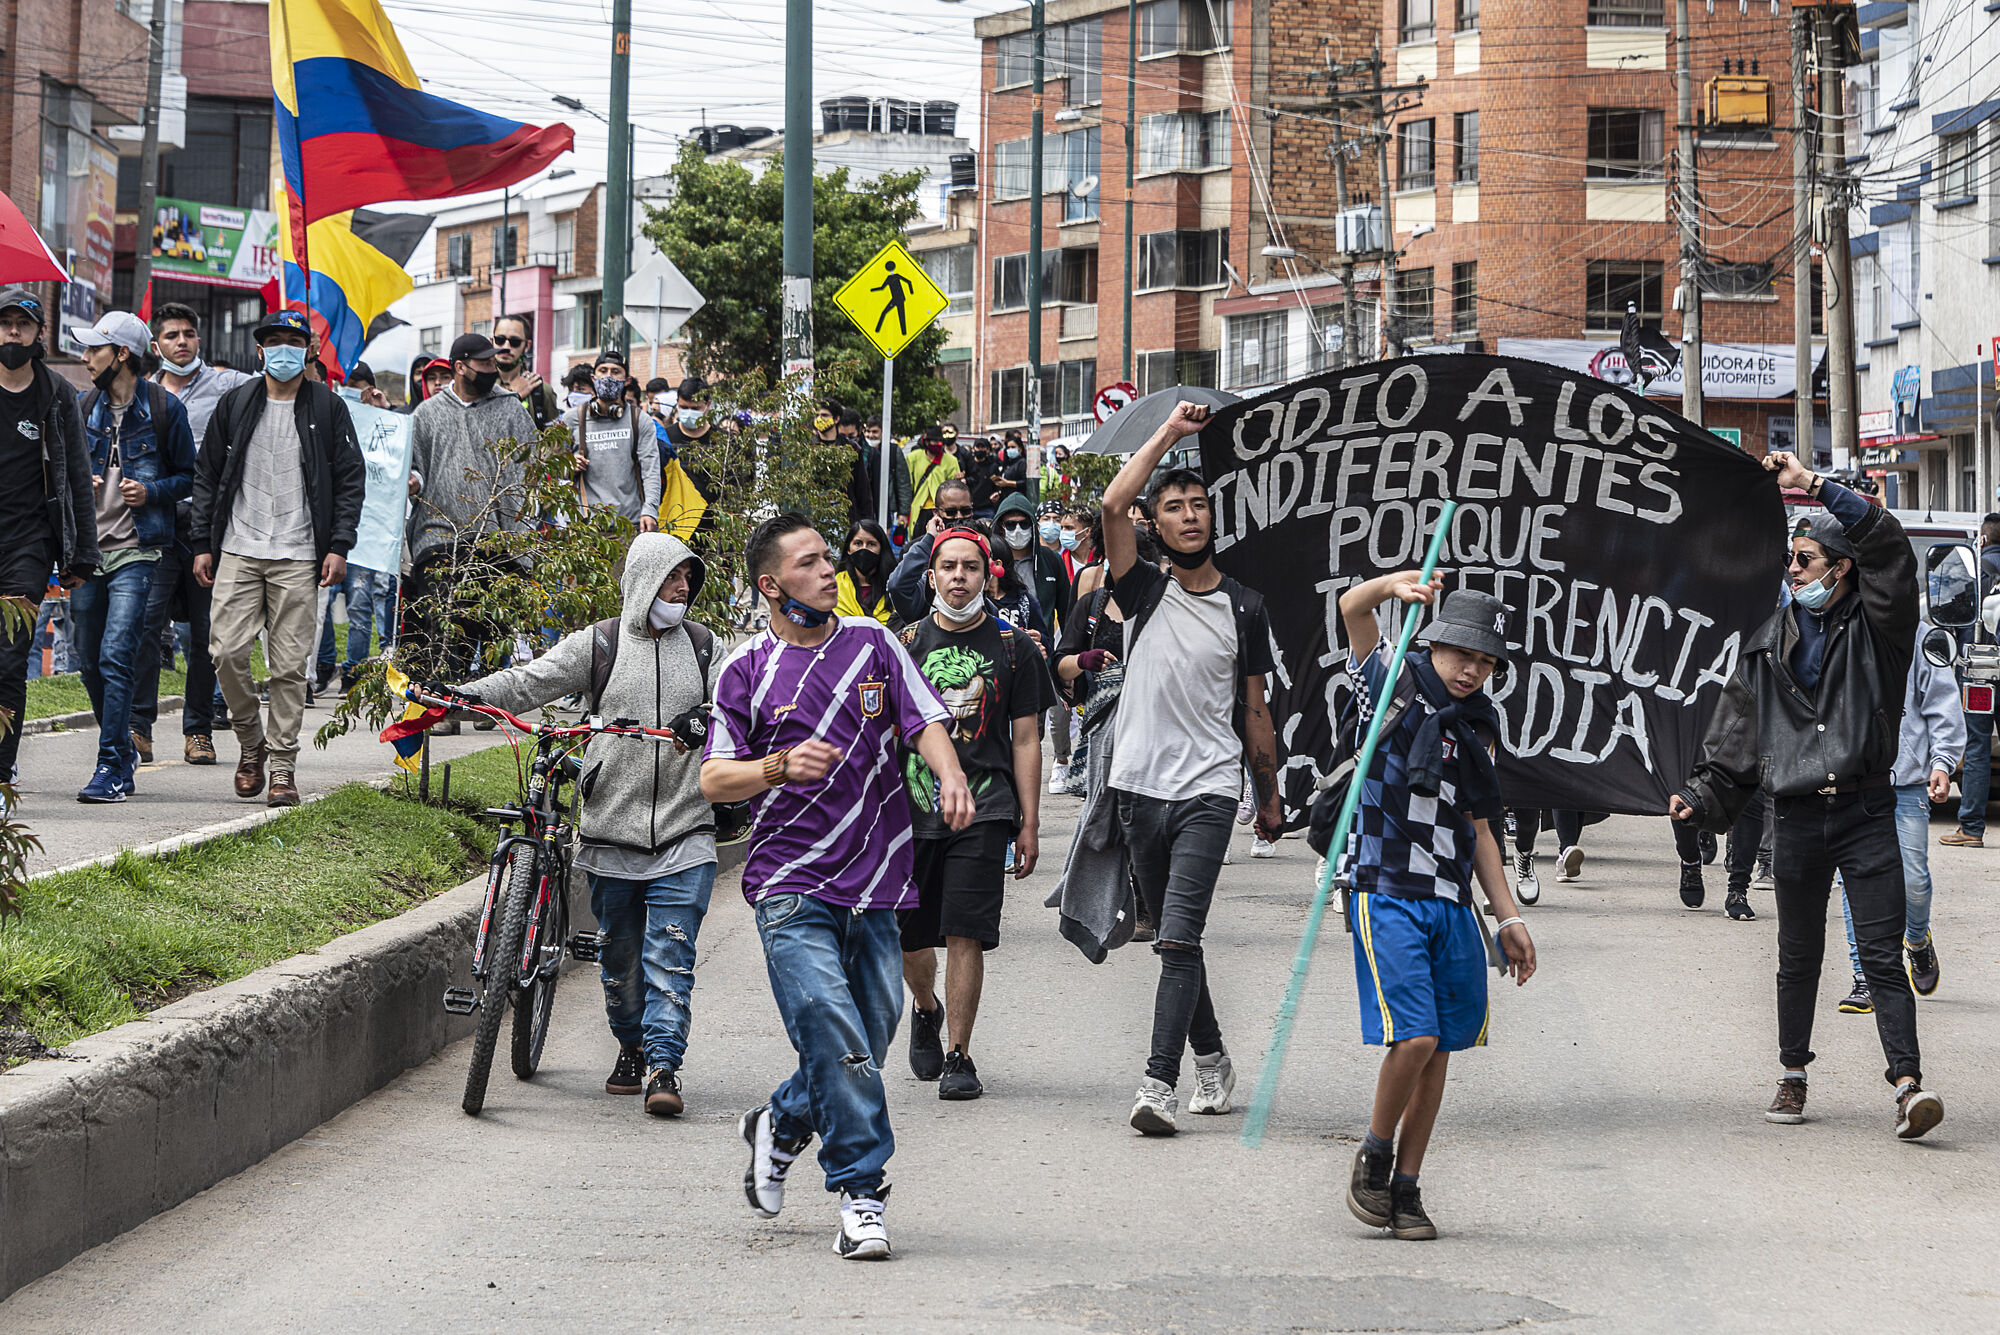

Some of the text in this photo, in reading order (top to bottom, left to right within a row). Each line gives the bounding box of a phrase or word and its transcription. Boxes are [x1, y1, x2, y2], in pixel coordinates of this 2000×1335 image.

[1704, 372, 1776, 386] AUTOPARTES
[1758, 358, 1776, 371] DE
[593, 441, 619, 451] SOCIAL
[1233, 364, 1680, 460] ODIO A LOS
[1207, 432, 1683, 554] INDIFERENTES
[1329, 498, 1567, 575] PORQUE
[1324, 660, 1653, 773] CRDIA
